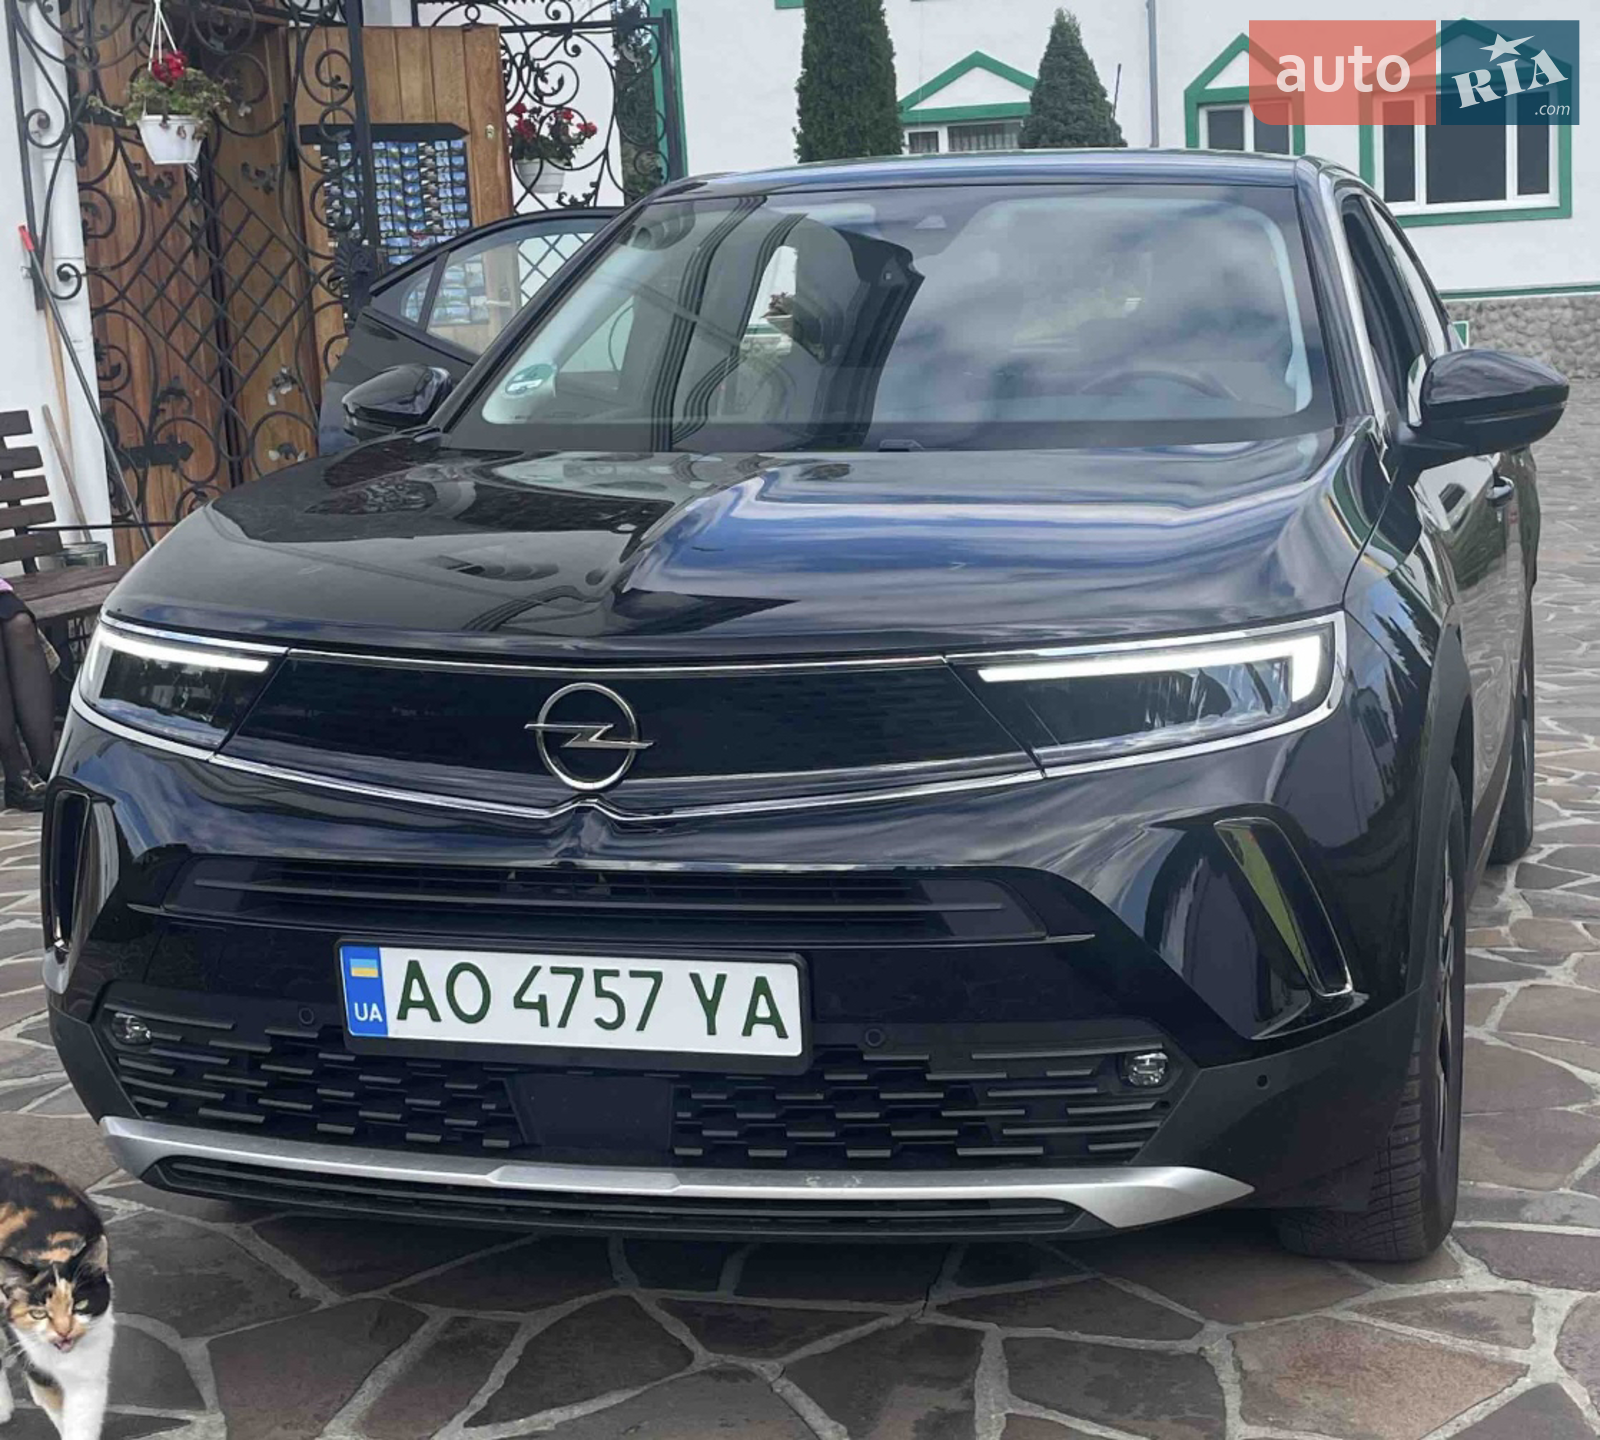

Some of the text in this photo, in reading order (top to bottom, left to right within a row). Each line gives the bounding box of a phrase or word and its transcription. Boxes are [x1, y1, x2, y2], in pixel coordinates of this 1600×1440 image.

[354, 1003, 383, 1023] UA
[396, 960, 789, 1039] AO 4757 YA
